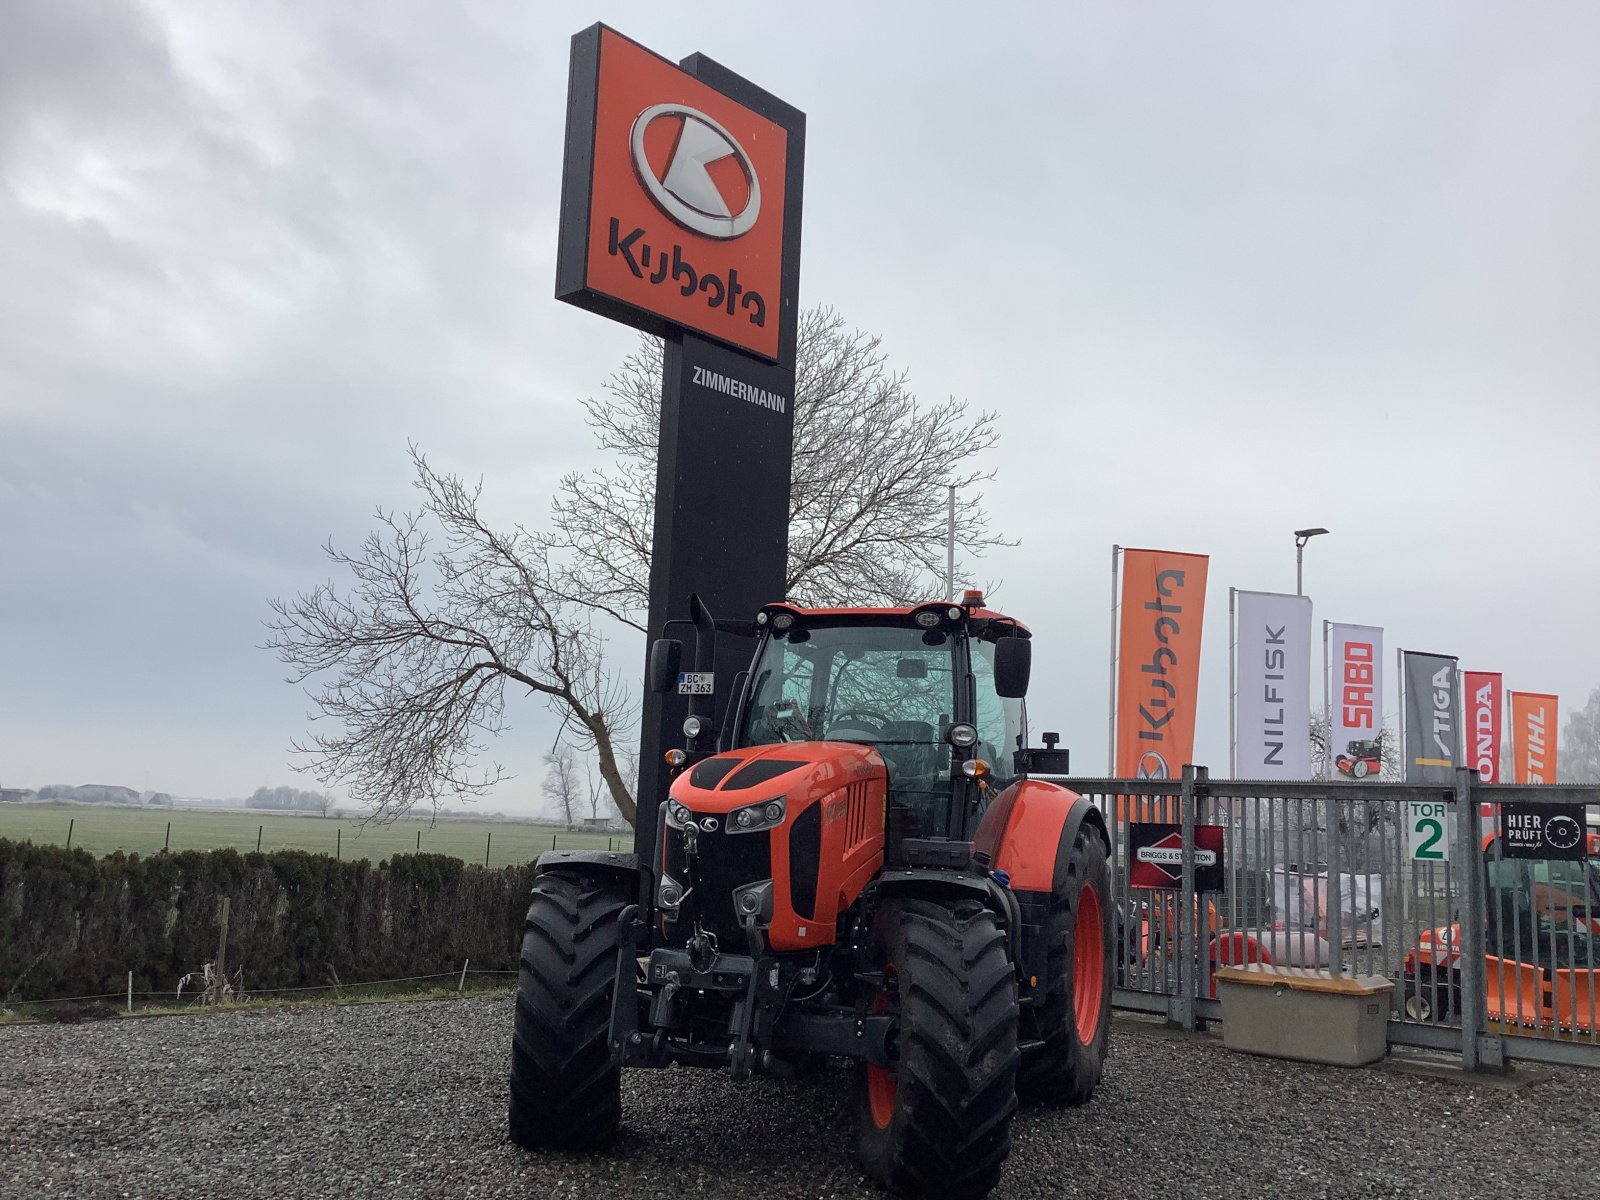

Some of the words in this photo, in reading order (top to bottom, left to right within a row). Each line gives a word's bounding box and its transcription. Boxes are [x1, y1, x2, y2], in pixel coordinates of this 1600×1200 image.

[608, 217, 766, 327] Kubota
[692, 366, 785, 414] ZIMMERMANN
[1138, 569, 1185, 741] Kubota
[687, 674, 698, 683] BC
[694, 684, 711, 692] 363
[1264, 624, 1285, 765] NILFISK
[1343, 641, 1373, 729] SABO
[1476, 682, 1493, 784] ONDA
[1410, 803, 1445, 817] TOR
[1508, 815, 1541, 828] HIER
[1415, 818, 1443, 859] 2
[1508, 828, 1542, 840] PRÜFT
[1140, 851, 1167, 860] BRIGGS
[1174, 853, 1212, 862] STTTON
